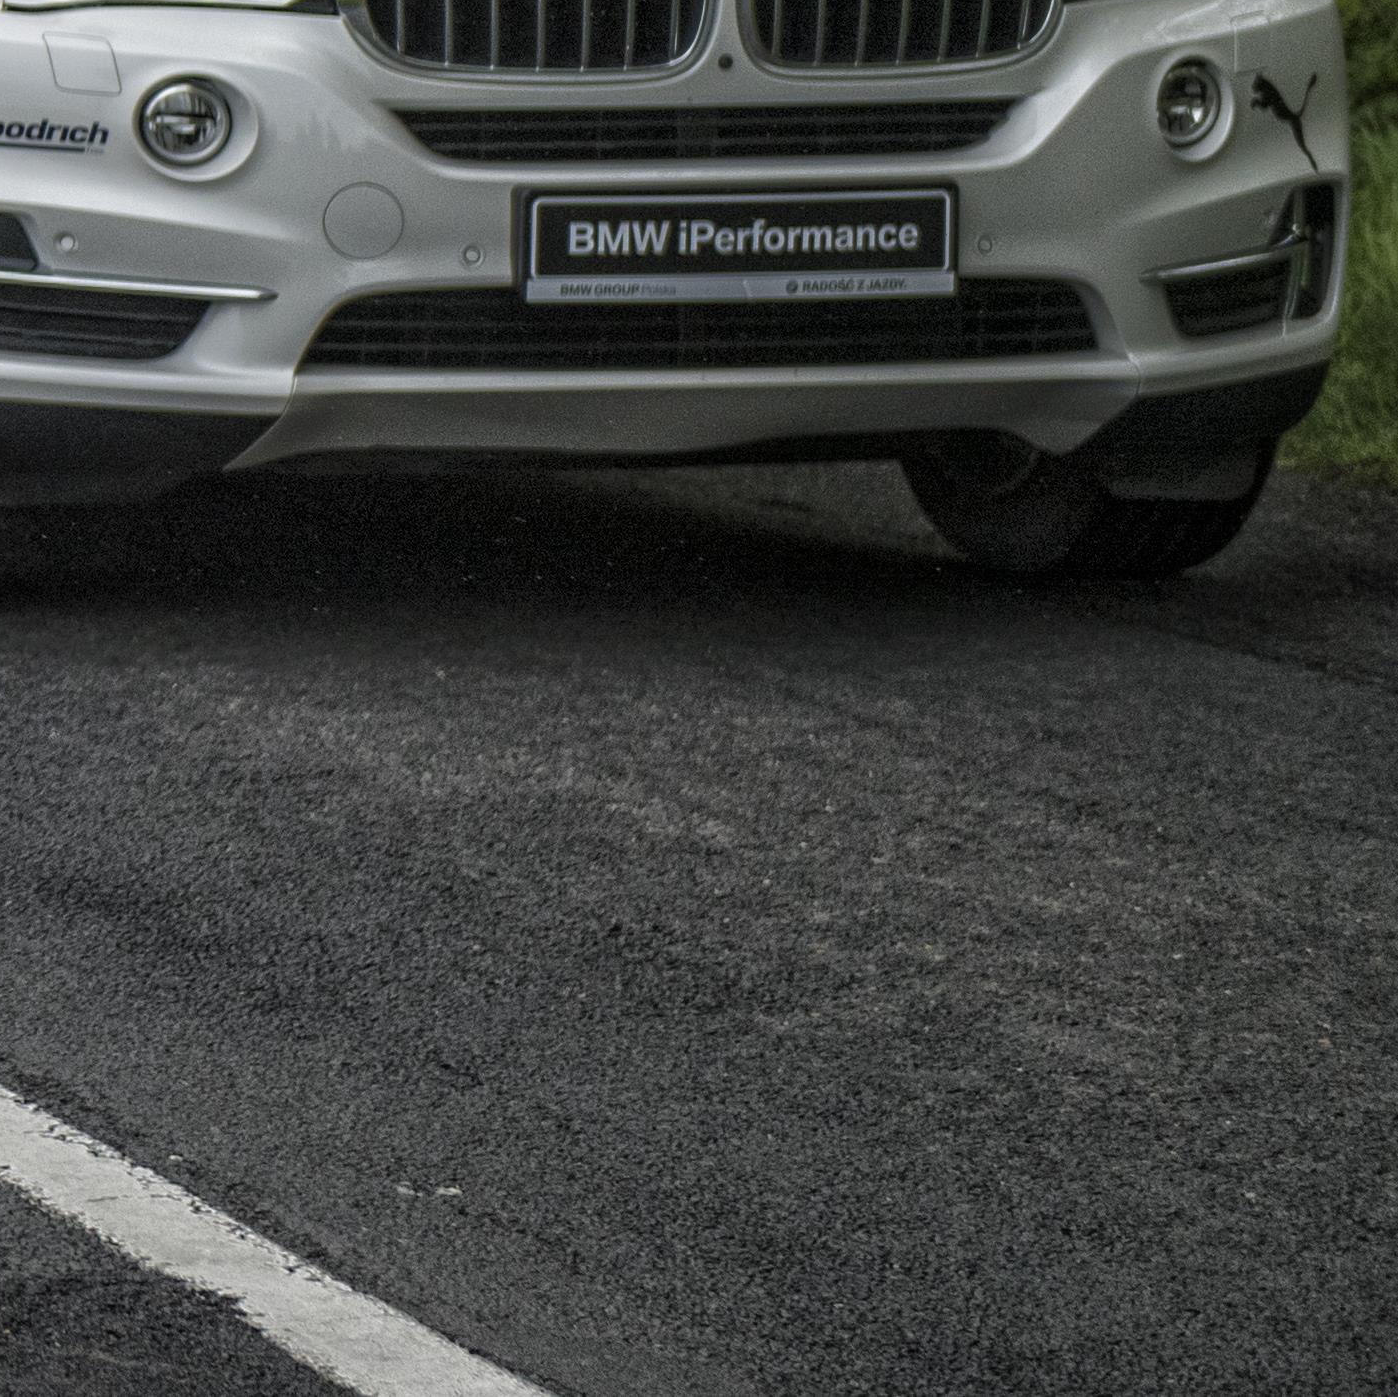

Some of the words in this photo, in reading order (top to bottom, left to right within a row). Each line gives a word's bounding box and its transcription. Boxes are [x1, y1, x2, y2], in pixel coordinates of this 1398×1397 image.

[567, 220, 670, 256] BMW
[678, 218, 920, 256] iPerformance
[559, 283, 592, 296] BMW
[594, 283, 640, 296] GROUP
